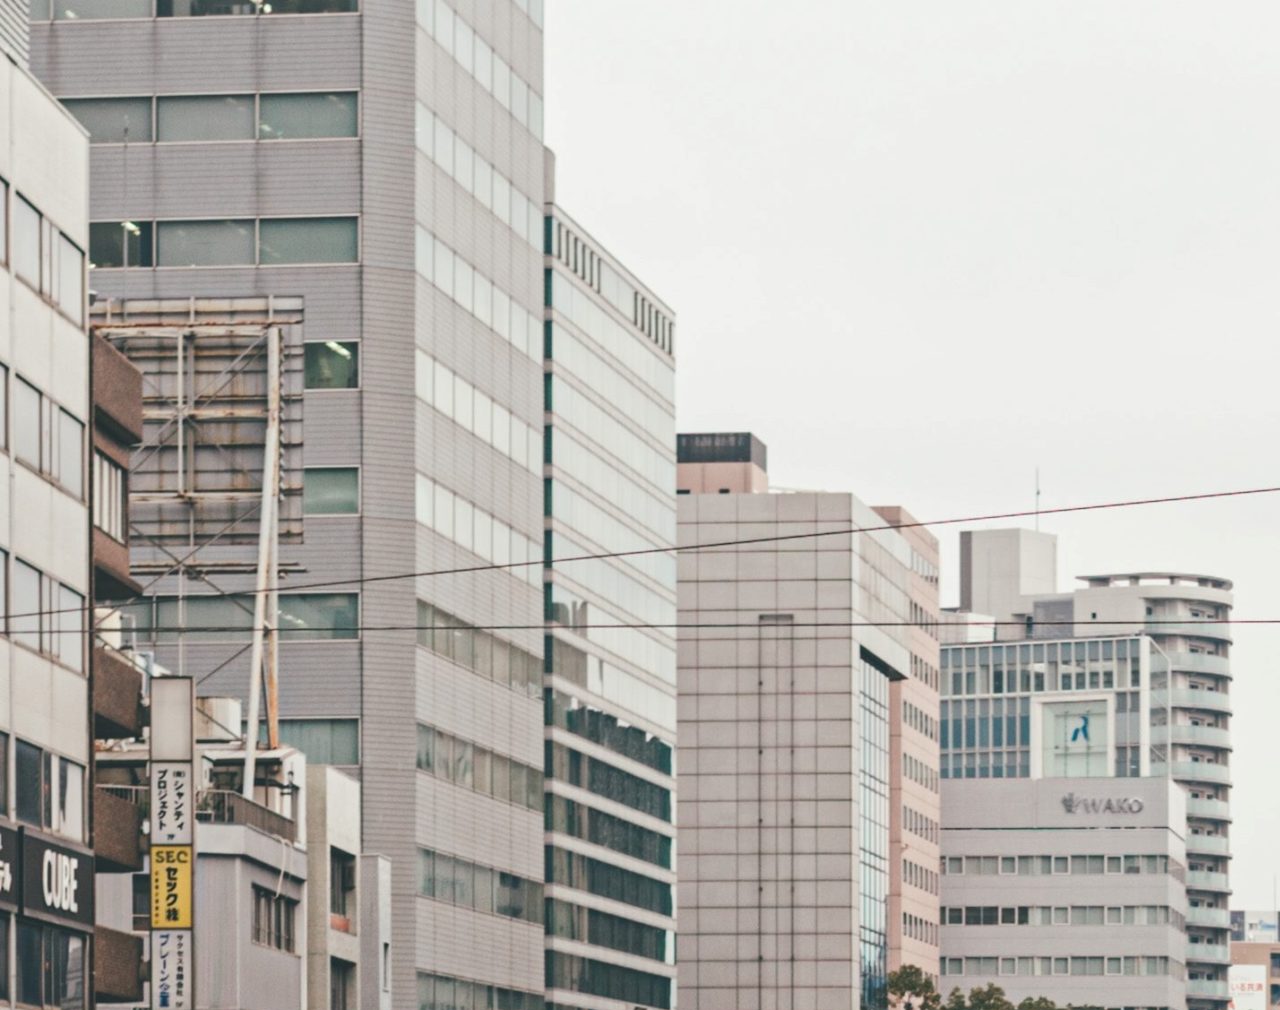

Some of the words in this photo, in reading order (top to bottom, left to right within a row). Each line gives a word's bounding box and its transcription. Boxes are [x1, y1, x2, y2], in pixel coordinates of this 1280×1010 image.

[1082, 798, 1144, 814] WAKO
[155, 850, 189, 864] SEC
[42, 849, 79, 913] CUBE
